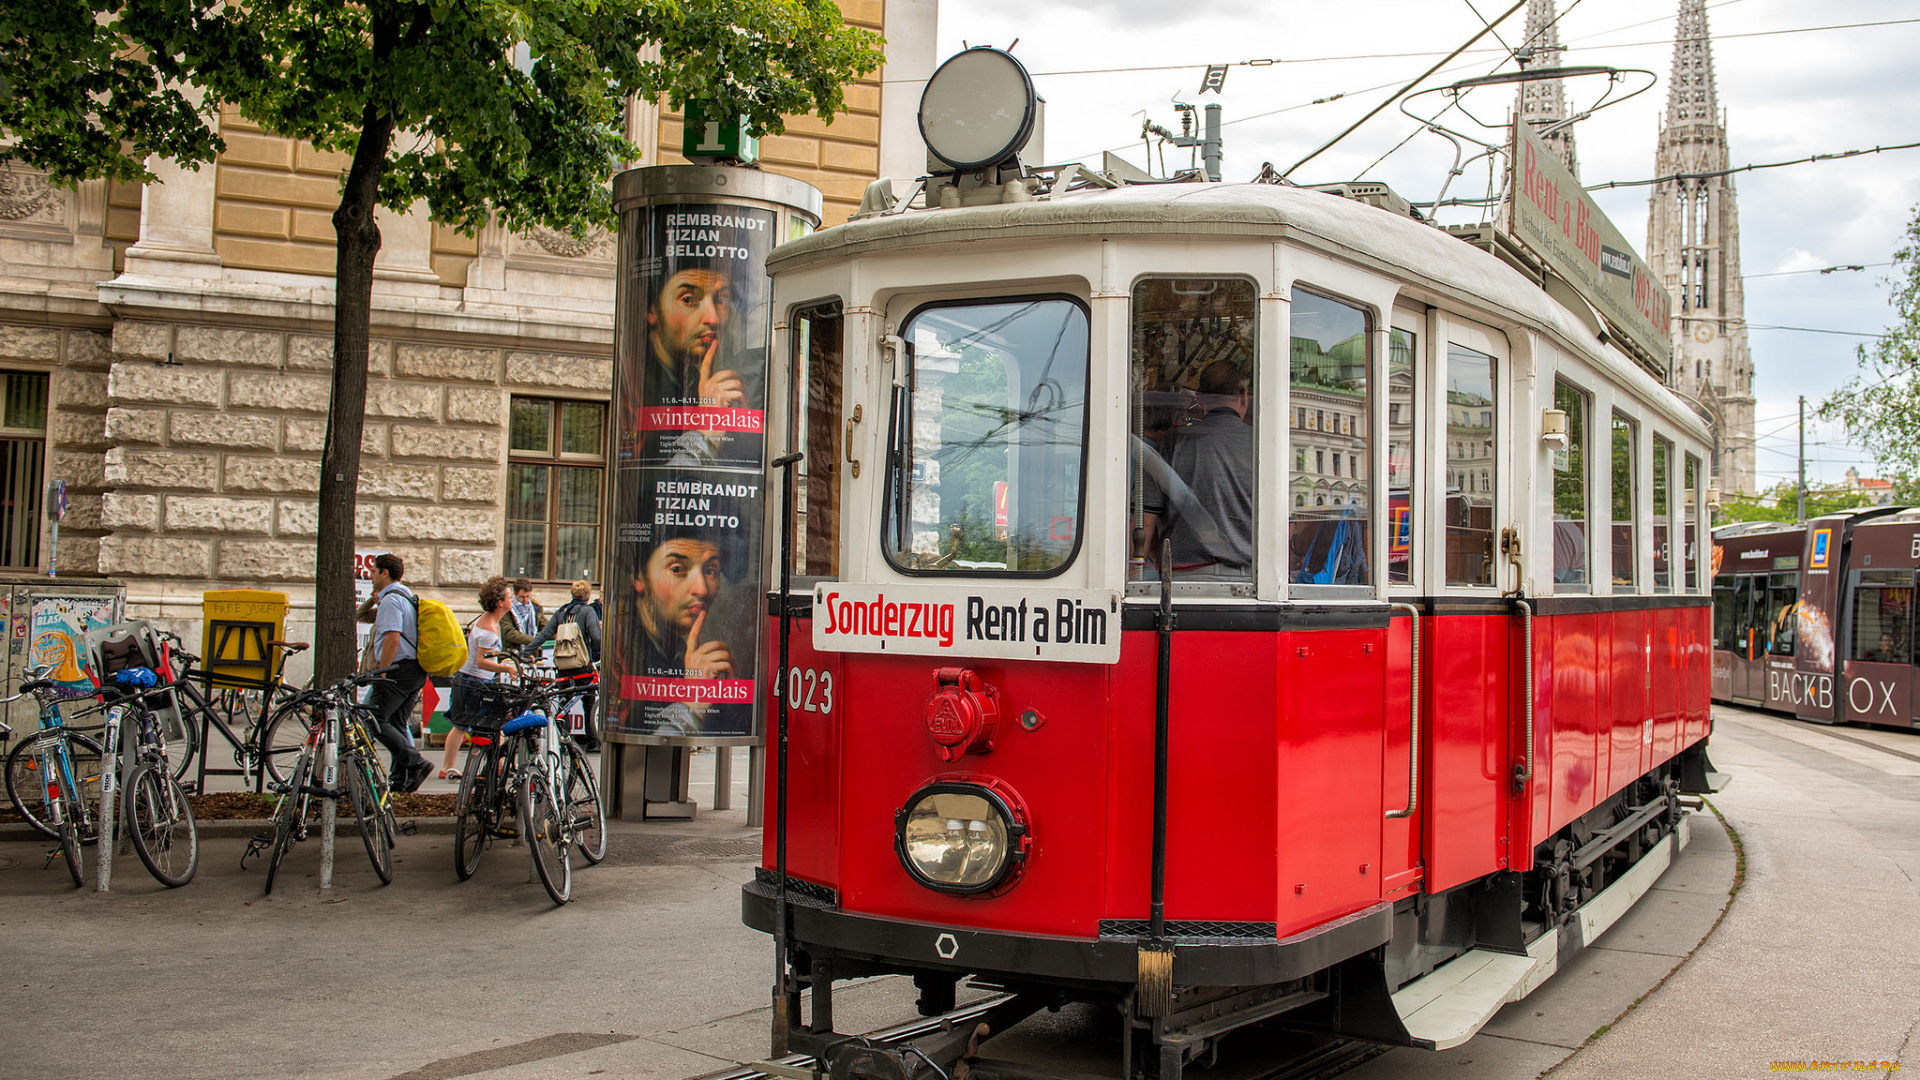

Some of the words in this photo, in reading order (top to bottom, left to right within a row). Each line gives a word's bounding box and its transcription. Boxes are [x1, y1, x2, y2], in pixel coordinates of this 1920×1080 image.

[1523, 137, 1559, 225] Rent
[1563, 200, 1571, 238] a
[1575, 197, 1599, 267] Bim
[666, 213, 766, 232] REMBRANDT
[666, 229, 720, 242] TIZIAN
[665, 244, 749, 260] BELLOTTO
[1635, 267, 1650, 319] 892
[1652, 287, 1660, 329] 13
[1661, 298, 1670, 339] 34
[651, 408, 760, 431] winterpalais
[656, 481, 758, 498] REMBRANDT
[655, 497, 710, 511] TIZIAN
[654, 513, 739, 528] BELLOTTO
[213, 603, 241, 615] FREE
[825, 592, 954, 647] Sonderzug
[966, 596, 1027, 641] Rent
[1033, 606, 1048, 643] a
[1056, 598, 1107, 645] Bim
[636, 679, 748, 703] winterpalais
